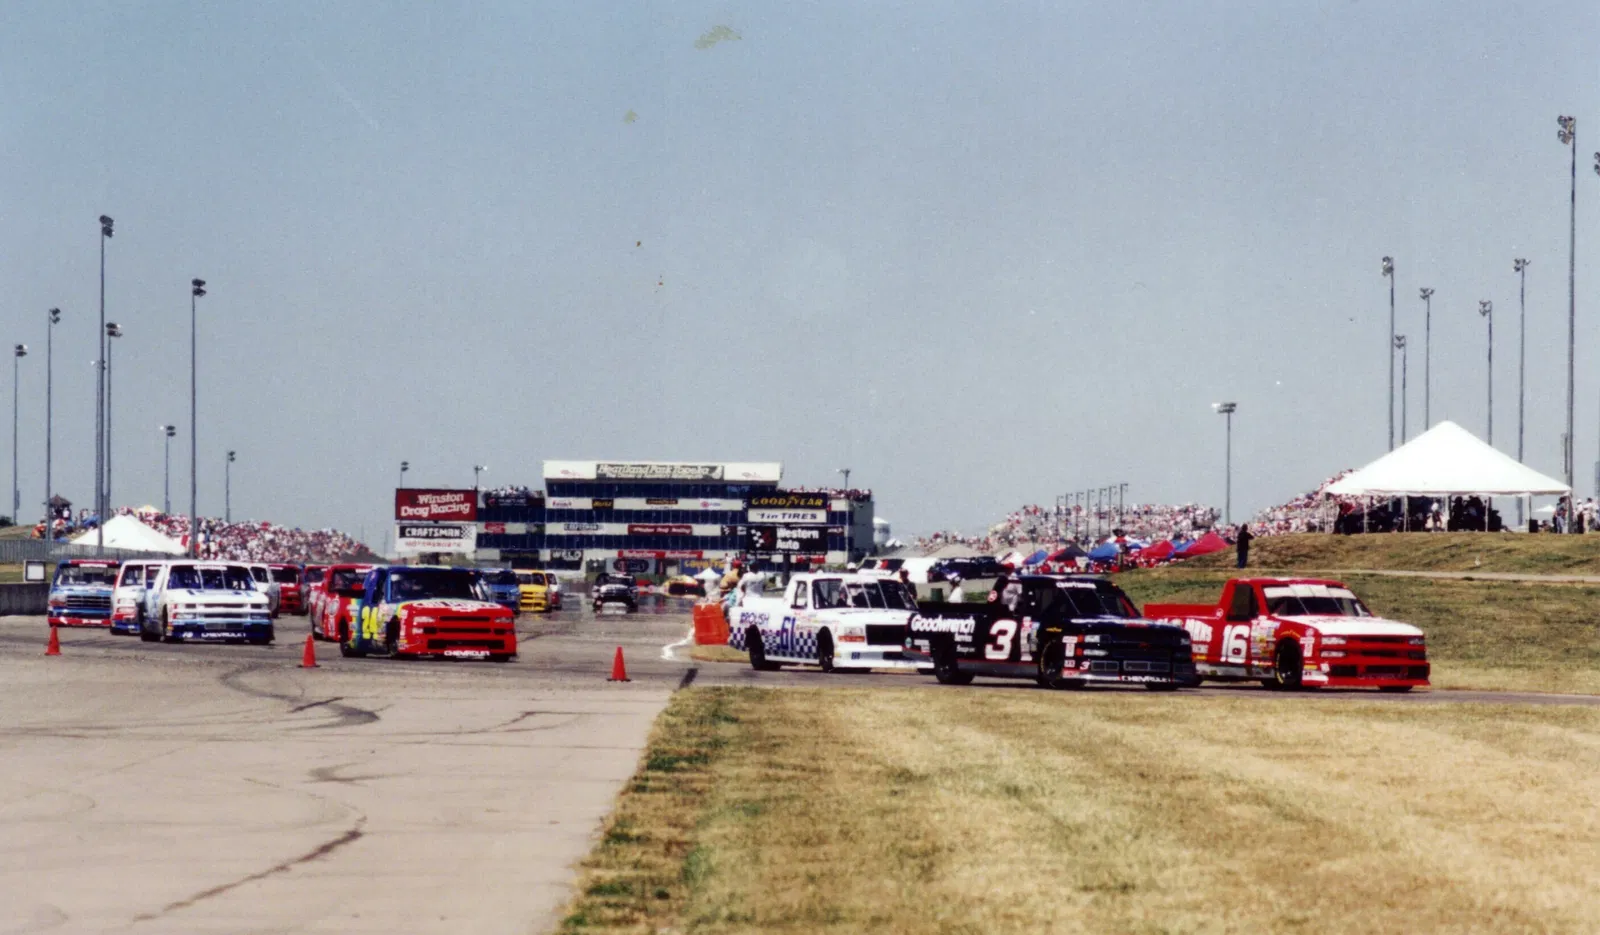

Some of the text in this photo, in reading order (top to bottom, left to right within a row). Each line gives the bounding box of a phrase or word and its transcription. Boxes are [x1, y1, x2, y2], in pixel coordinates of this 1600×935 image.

[417, 492, 464, 505] Winston
[751, 496, 823, 508] GOODYEAR
[401, 502, 471, 518] Drag Racing
[781, 512, 817, 520] TIRES
[405, 528, 460, 538] CRAFTSMAN
[776, 527, 819, 539] Western
[776, 539, 800, 550] Auto
[552, 550, 582, 560] WELD
[911, 614, 975, 633] Goodwrench
[780, 616, 796, 651] 61
[985, 619, 1018, 660] 3
[1220, 624, 1250, 664] 16
[1121, 675, 1172, 683] CHEVROLET
